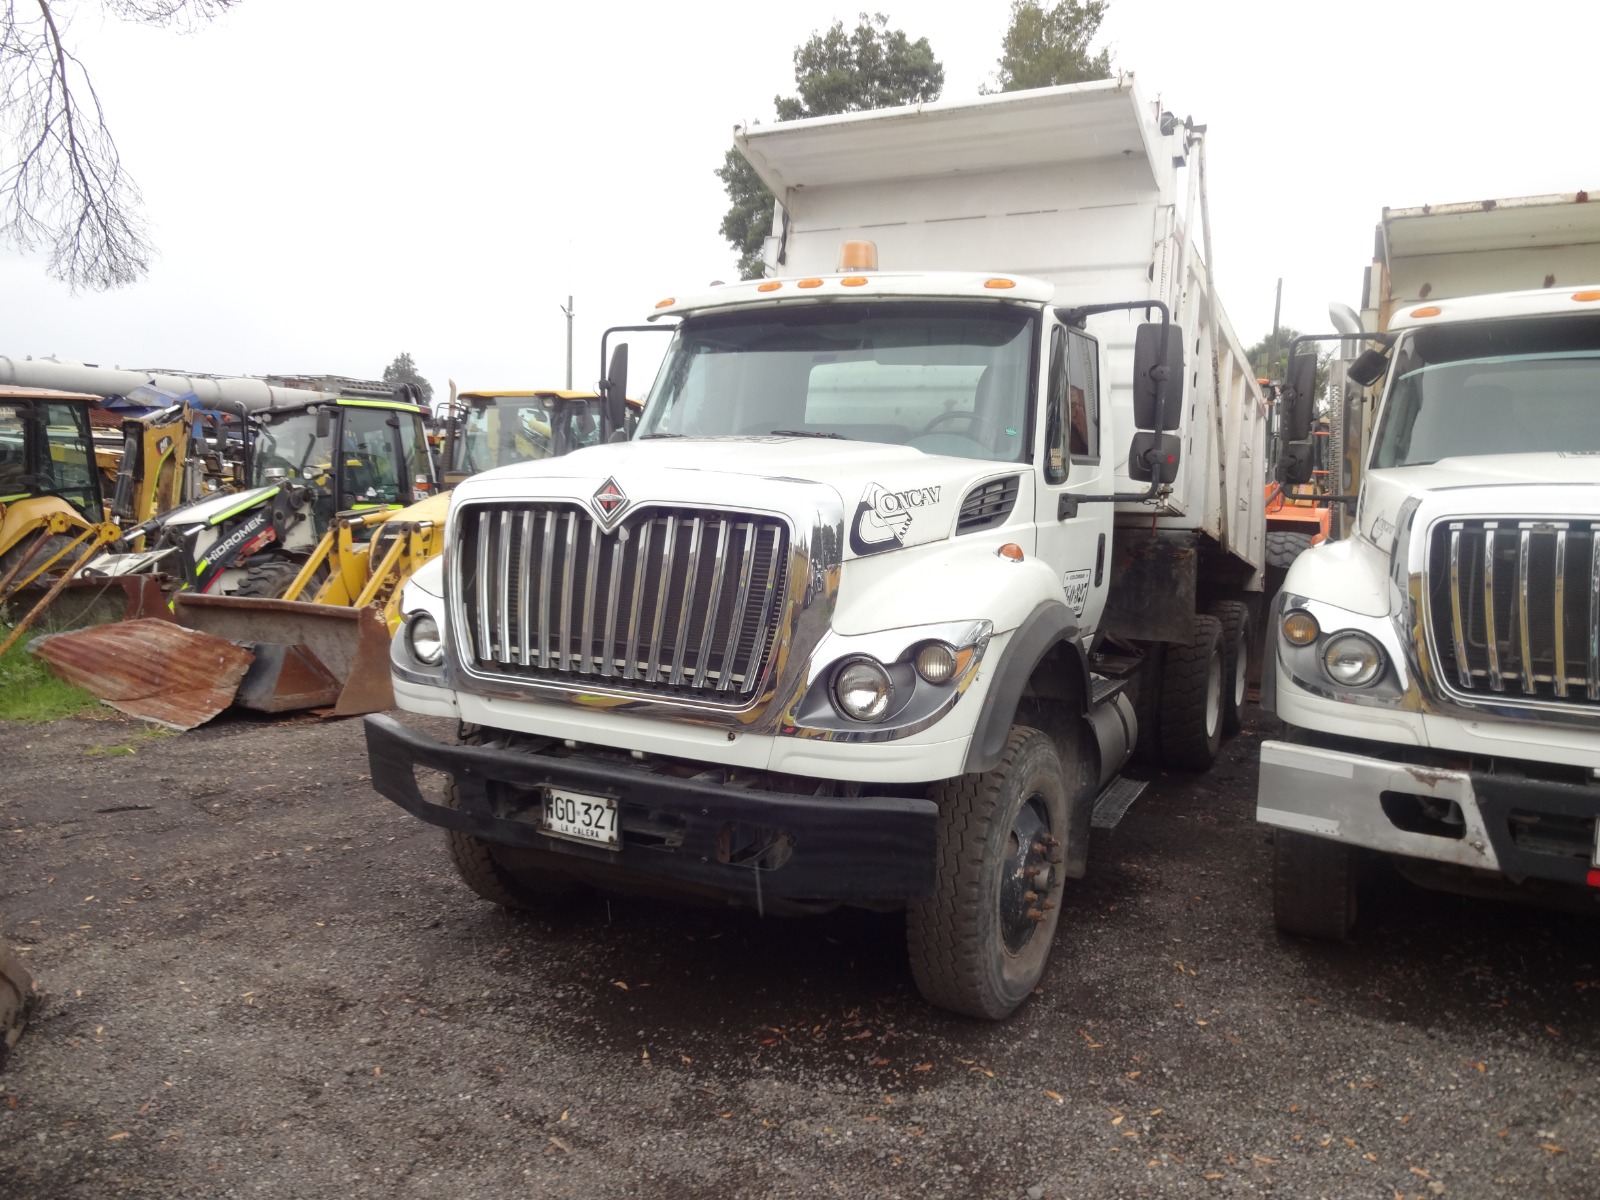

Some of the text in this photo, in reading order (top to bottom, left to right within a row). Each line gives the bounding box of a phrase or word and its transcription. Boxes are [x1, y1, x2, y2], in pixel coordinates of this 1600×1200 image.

[581, 801, 617, 832] 327
[561, 824, 600, 838] LA CALERA
